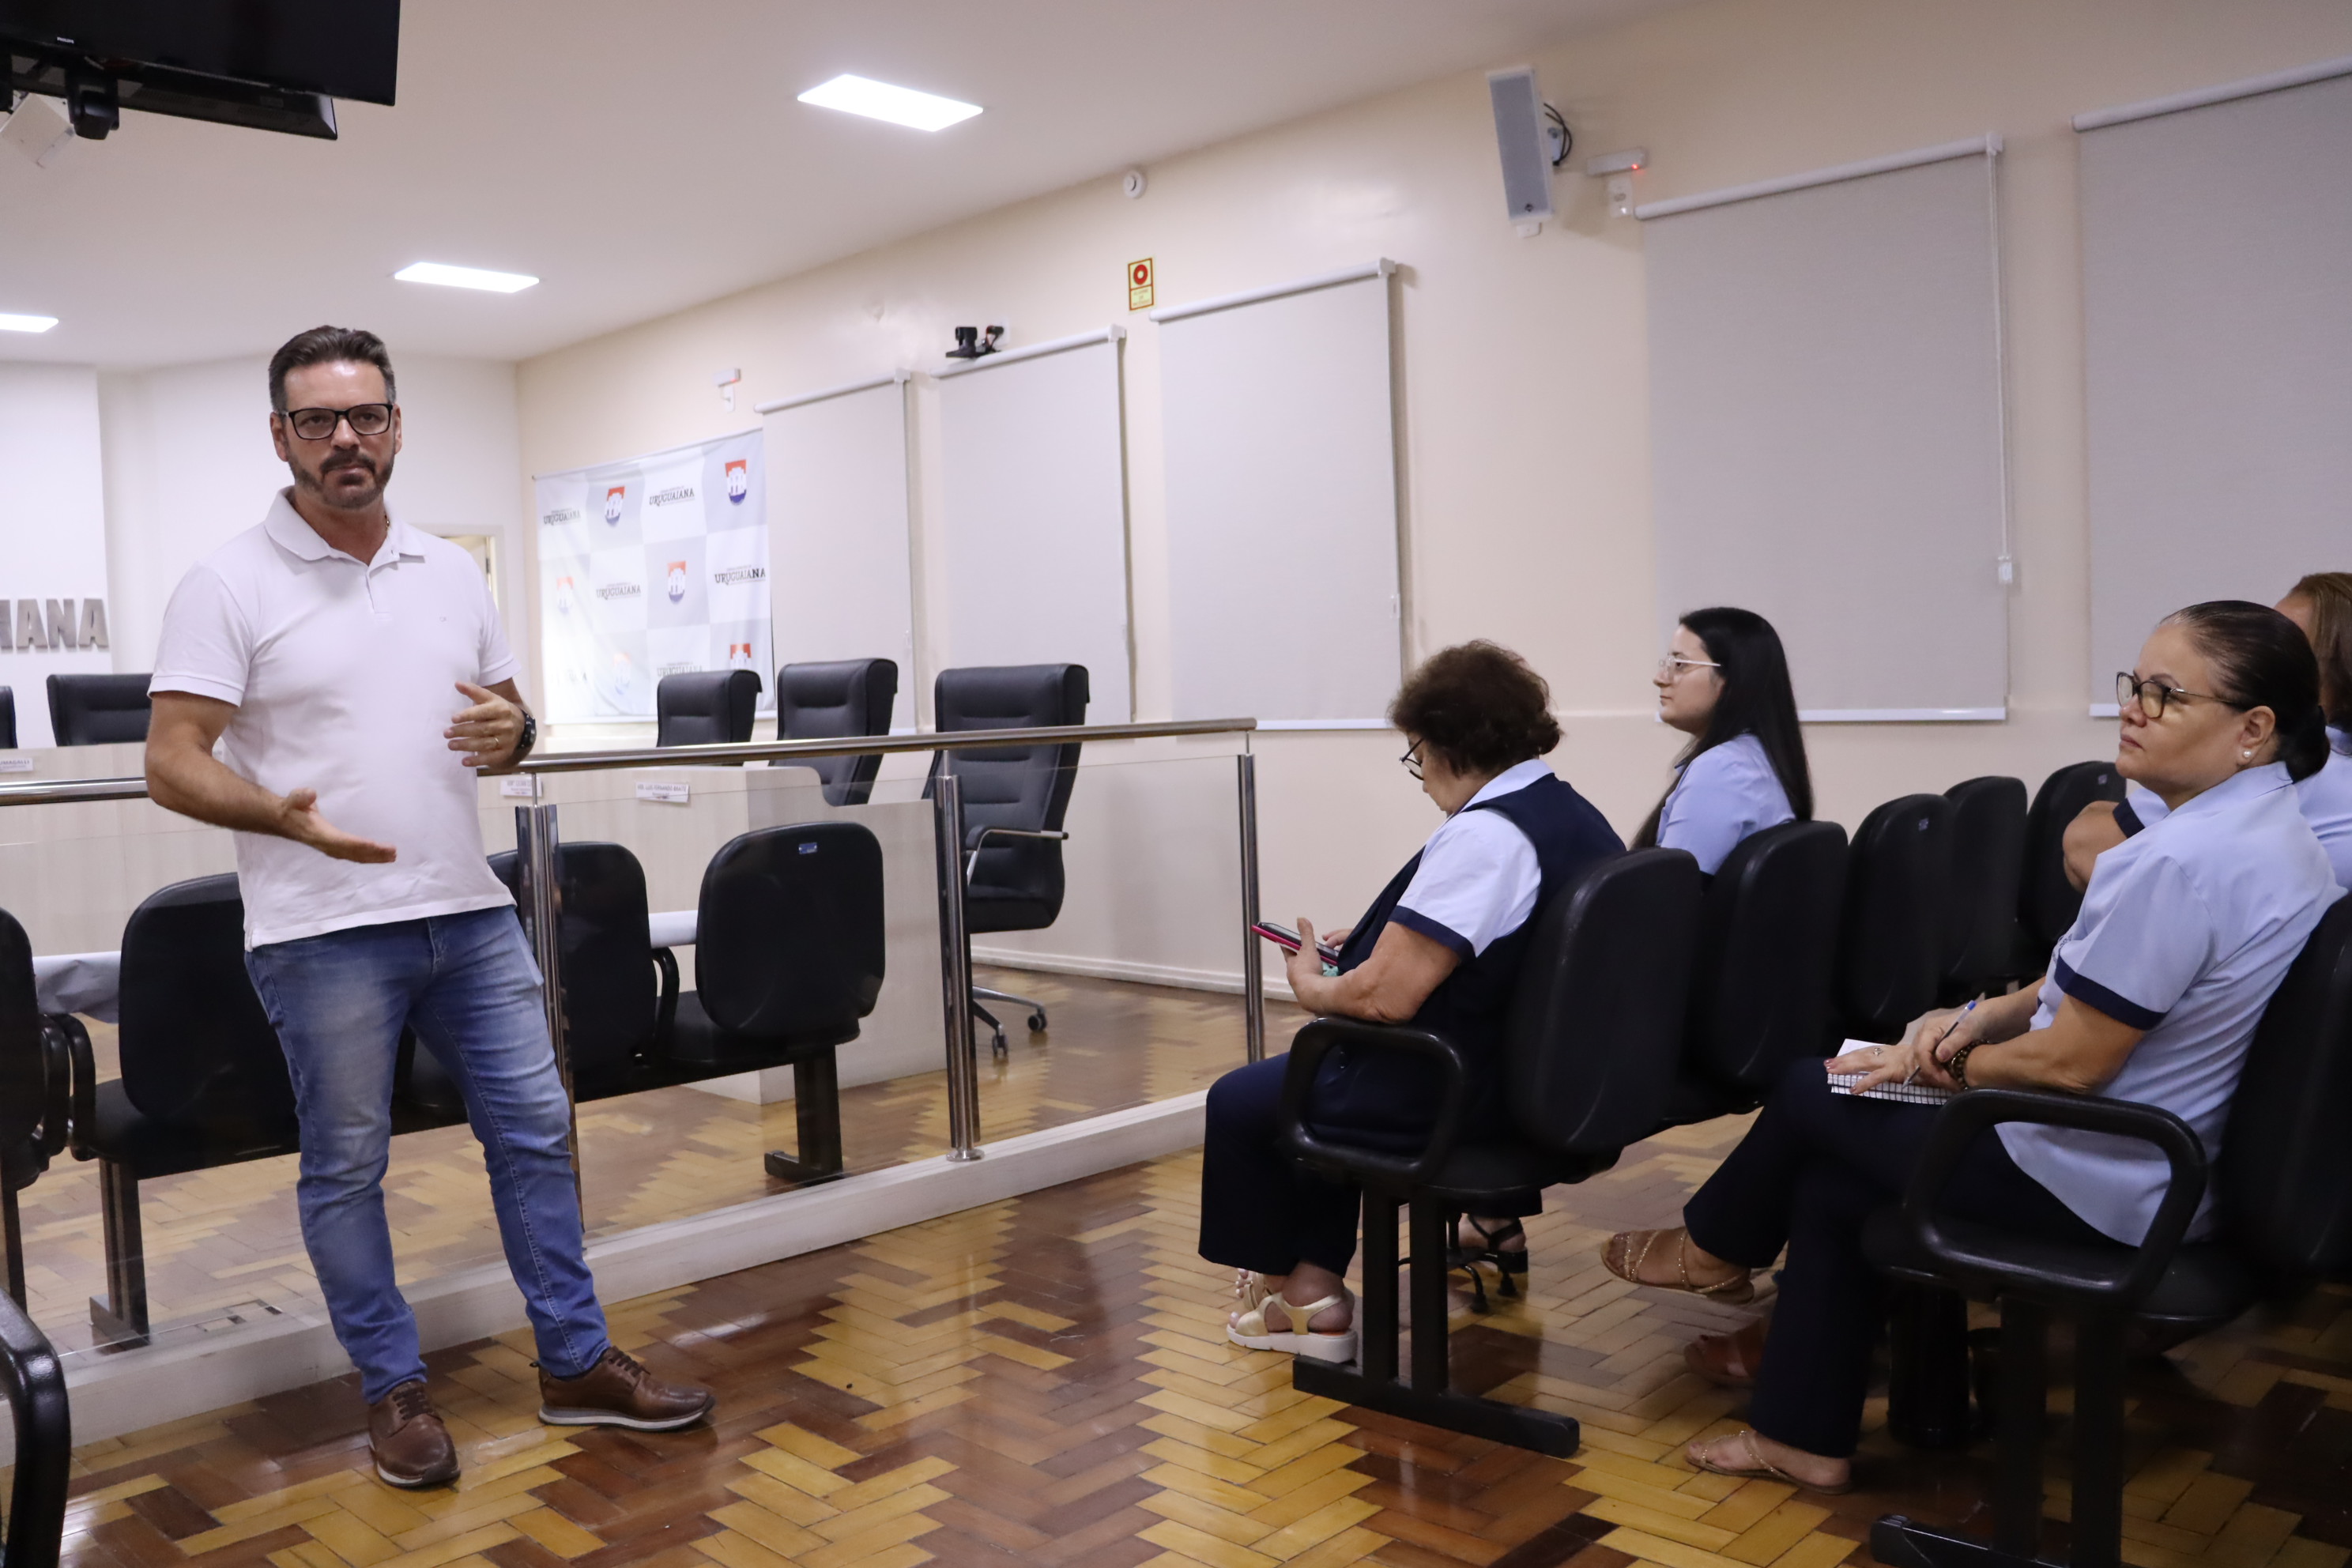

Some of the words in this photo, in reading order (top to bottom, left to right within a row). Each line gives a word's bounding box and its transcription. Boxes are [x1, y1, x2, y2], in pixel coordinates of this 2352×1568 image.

[650, 488, 695, 507] URUGUAIANA
[714, 567, 766, 586] URUGUAIANA
[596, 584, 641, 601] URUGUAIANA
